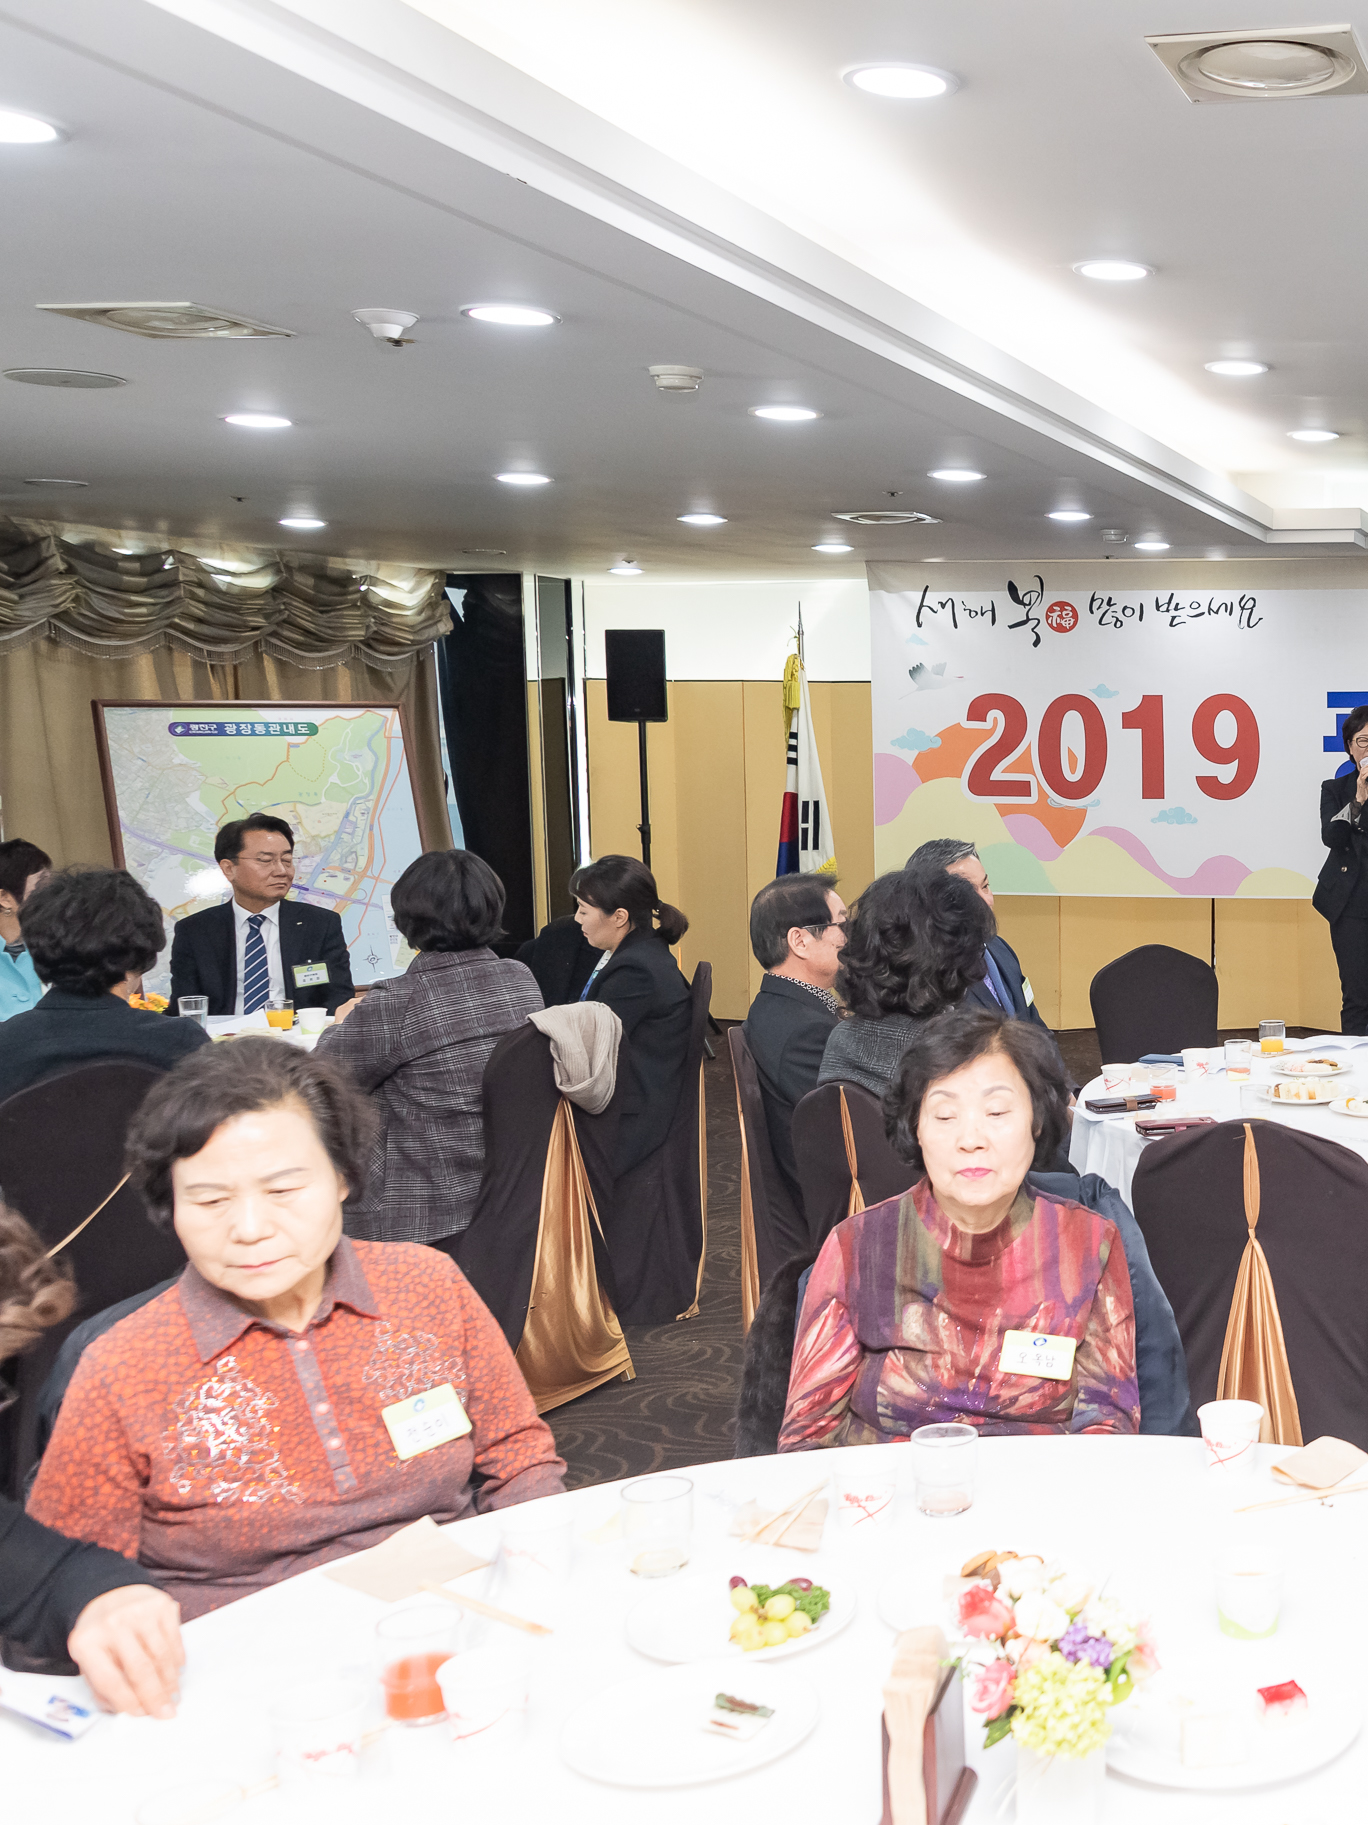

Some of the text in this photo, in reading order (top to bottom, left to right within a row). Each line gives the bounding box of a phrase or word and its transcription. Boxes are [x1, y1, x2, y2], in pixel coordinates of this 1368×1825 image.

[916, 574, 1264, 648] 새해 복 福 많이 받으세요
[966, 693, 1260, 800] 2019
